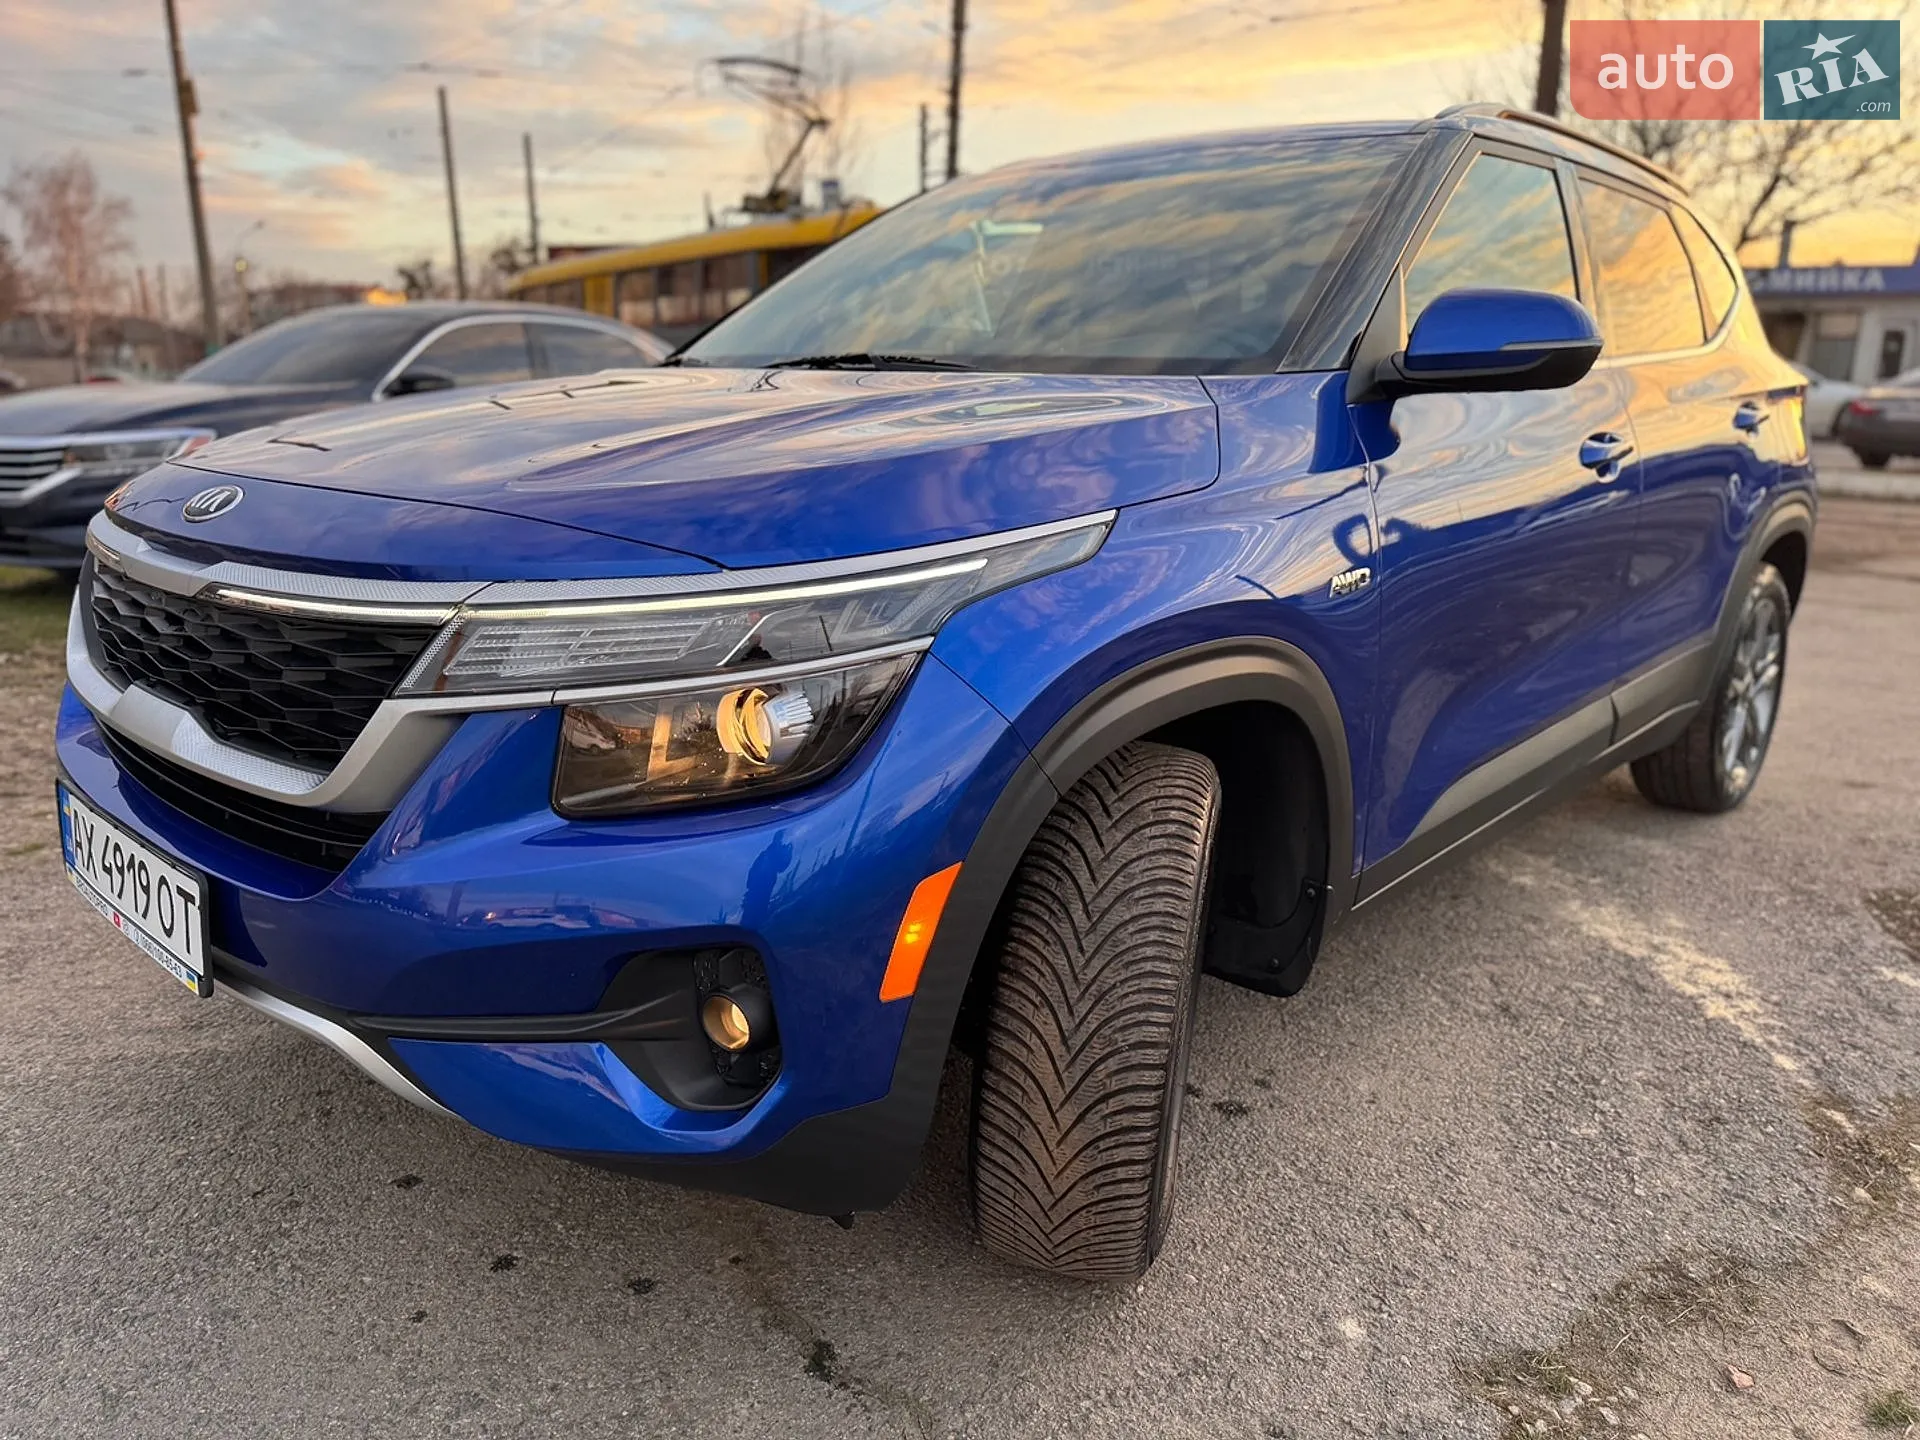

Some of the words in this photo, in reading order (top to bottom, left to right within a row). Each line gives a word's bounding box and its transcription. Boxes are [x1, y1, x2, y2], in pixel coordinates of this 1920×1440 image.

[188, 487, 234, 514] KIA
[1329, 567, 1371, 598] AWD
[72, 808, 99, 881] AX
[101, 834, 151, 921] 4919
[157, 874, 196, 956] OT
